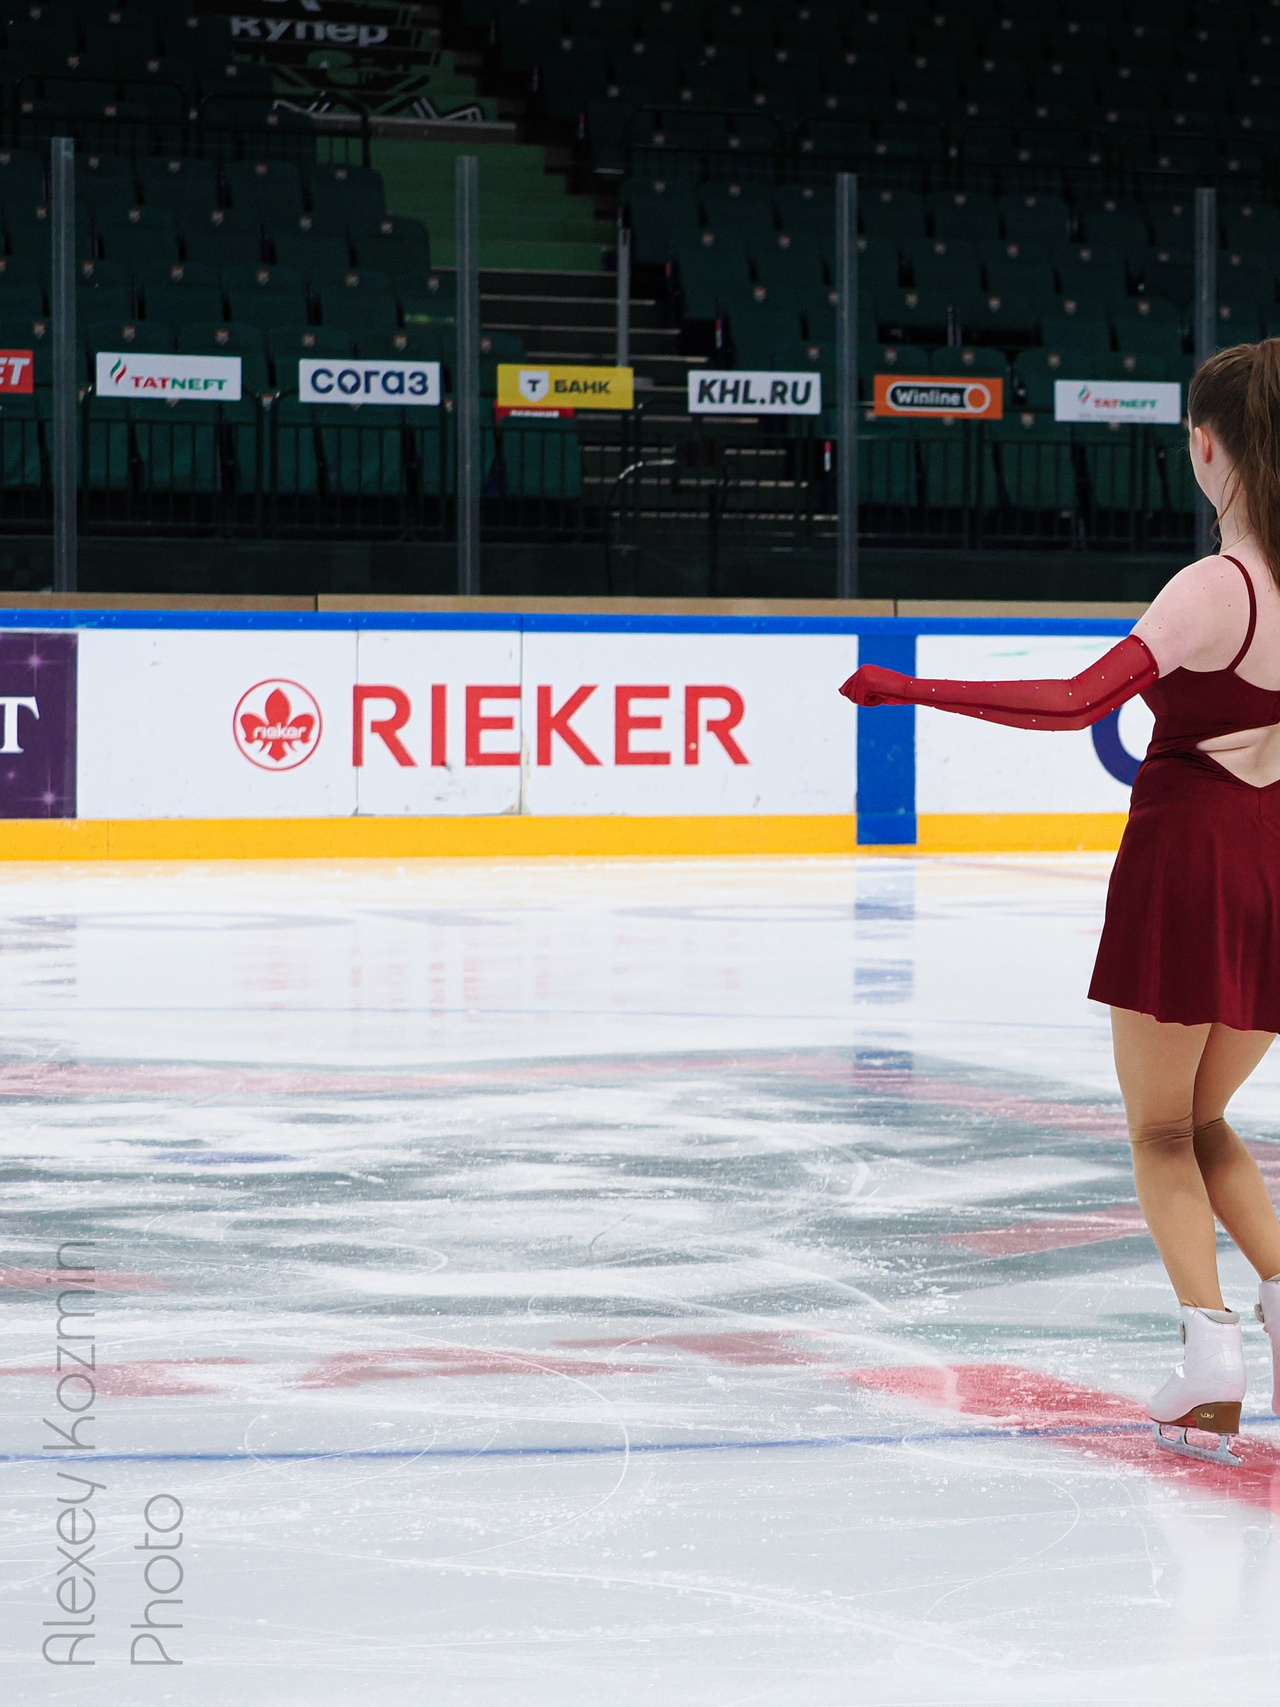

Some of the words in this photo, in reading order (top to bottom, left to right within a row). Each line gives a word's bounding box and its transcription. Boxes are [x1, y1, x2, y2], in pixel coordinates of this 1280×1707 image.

[131, 376, 228, 391] TATNEFT
[554, 379, 611, 394] БАНК
[698, 379, 812, 405] KHL.RU
[895, 388, 961, 406] Winline
[253, 722, 307, 739] rieker
[352, 684, 751, 768] RIEKER
